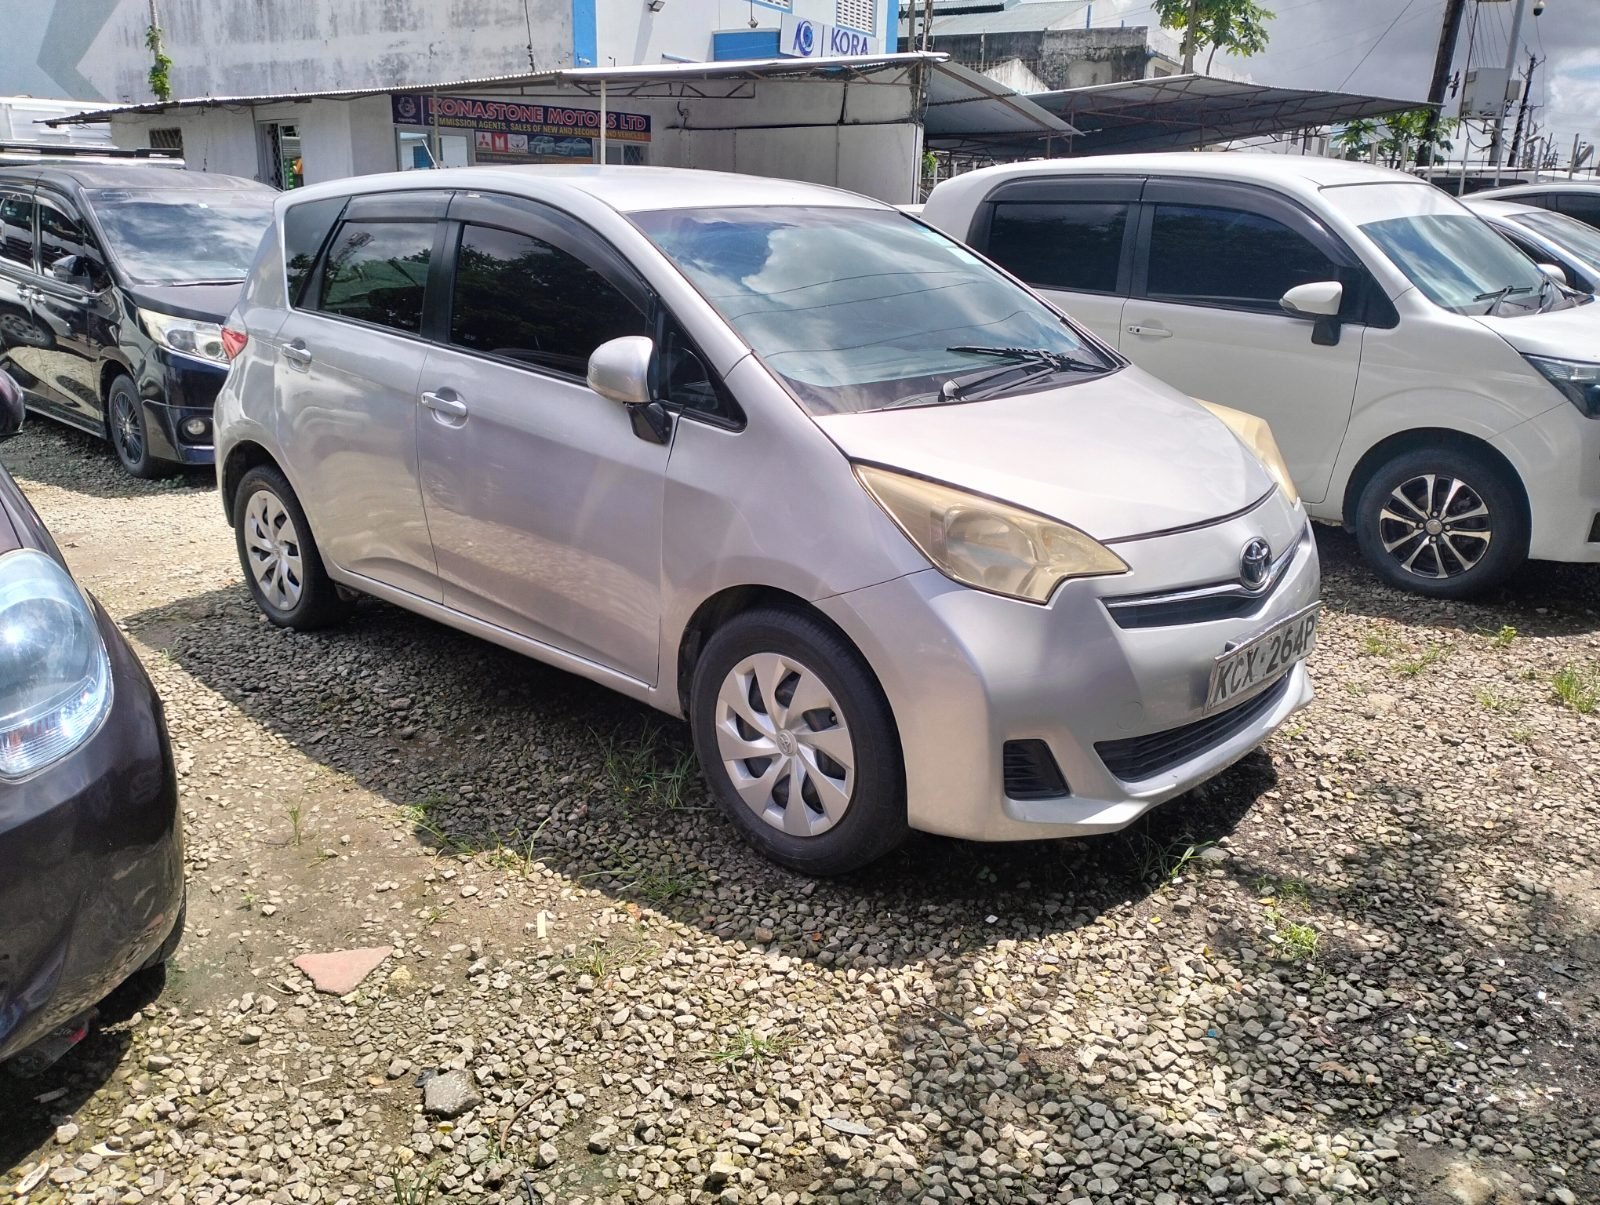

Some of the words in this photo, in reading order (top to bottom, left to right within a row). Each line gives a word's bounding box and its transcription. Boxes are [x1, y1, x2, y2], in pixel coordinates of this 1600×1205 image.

[831, 28, 868, 56] KORA
[428, 116, 477, 128] CMMISSION
[510, 122, 532, 132] SALES
[533, 124, 541, 133] OF
[543, 125, 558, 134] NEW
[560, 126, 572, 135] AND
[574, 127, 599, 136] SECOND
[547, 108, 617, 129] MOTOS
[620, 115, 646, 131] LTD
